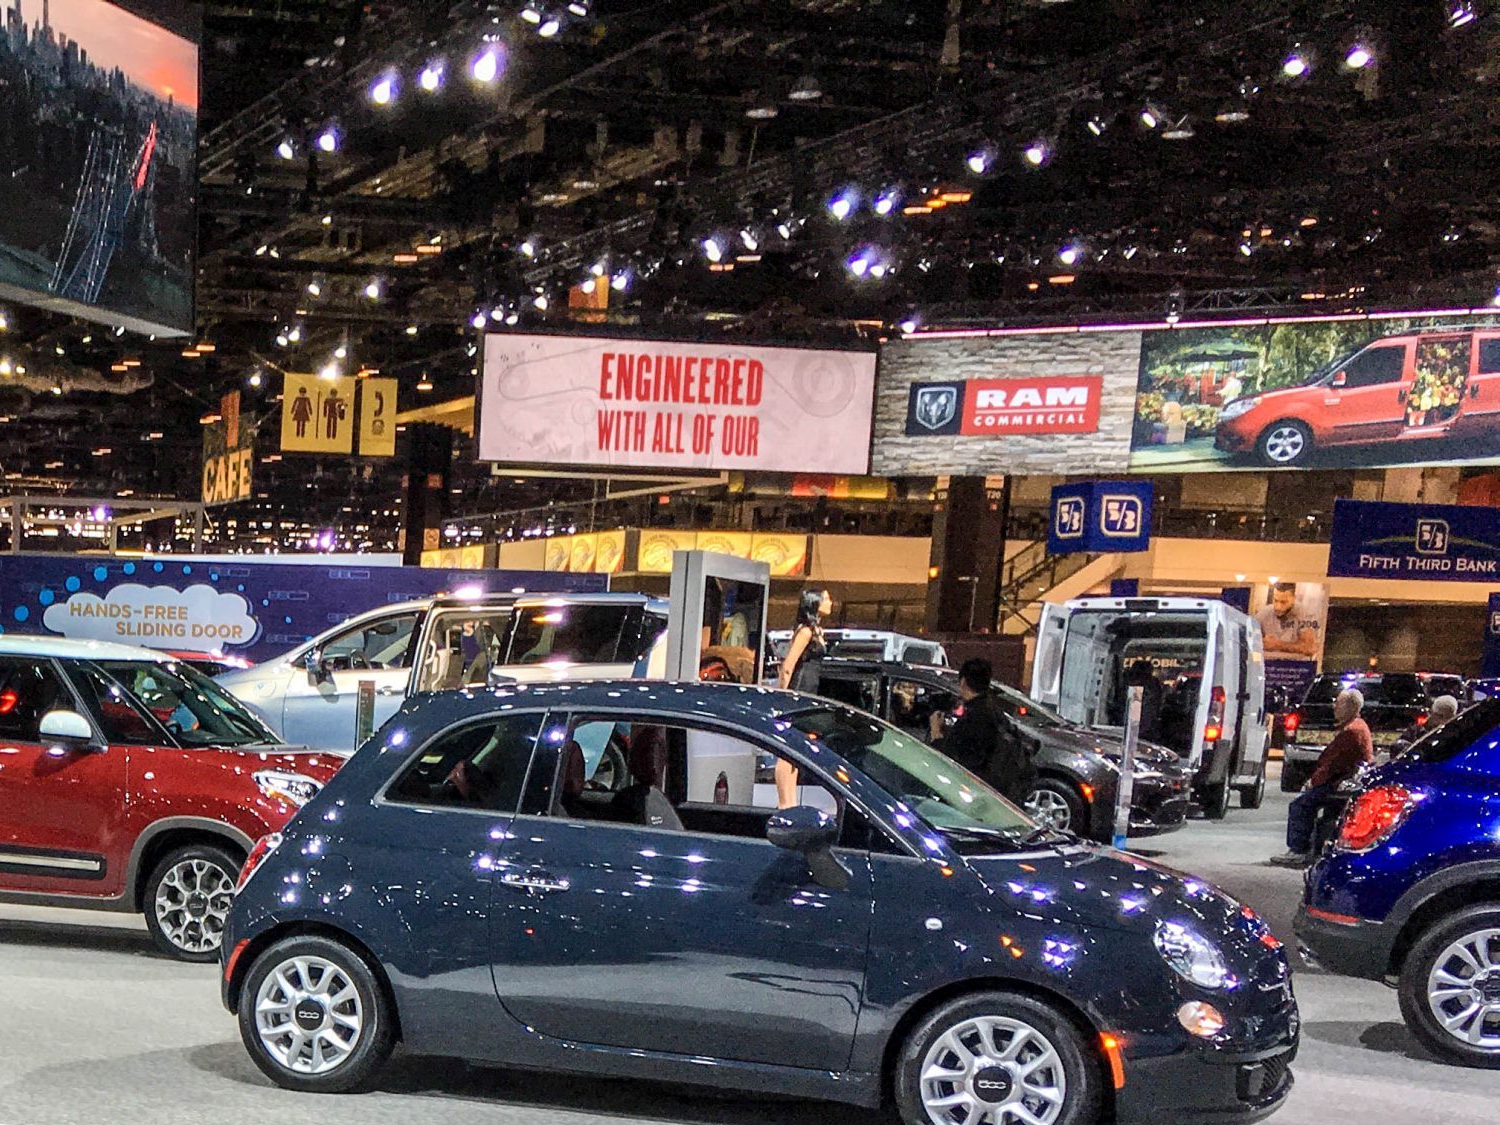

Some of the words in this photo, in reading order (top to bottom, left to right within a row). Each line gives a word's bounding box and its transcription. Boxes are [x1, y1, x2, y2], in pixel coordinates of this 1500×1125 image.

[599, 352, 764, 407] ENGINEERED
[976, 386, 1089, 409] RAM
[973, 413, 1086, 427] COMMERCIAL
[598, 409, 648, 452] WITH
[652, 412, 685, 454] ALL
[692, 413, 717, 455] OF
[721, 414, 760, 456] OUR
[203, 448, 251, 502] CAFE
[1106, 501, 1137, 530] 5/3
[1360, 554, 1400, 569] FIFTH
[1406, 556, 1450, 571] THIRD
[1456, 558, 1497, 572] BANK
[69, 602, 189, 620] HANDS-FREE
[116, 621, 186, 638] SLIDING
[191, 623, 243, 638] DOOR
[298, 1010, 320, 1020] 500
[978, 1080, 1007, 1090] 500
